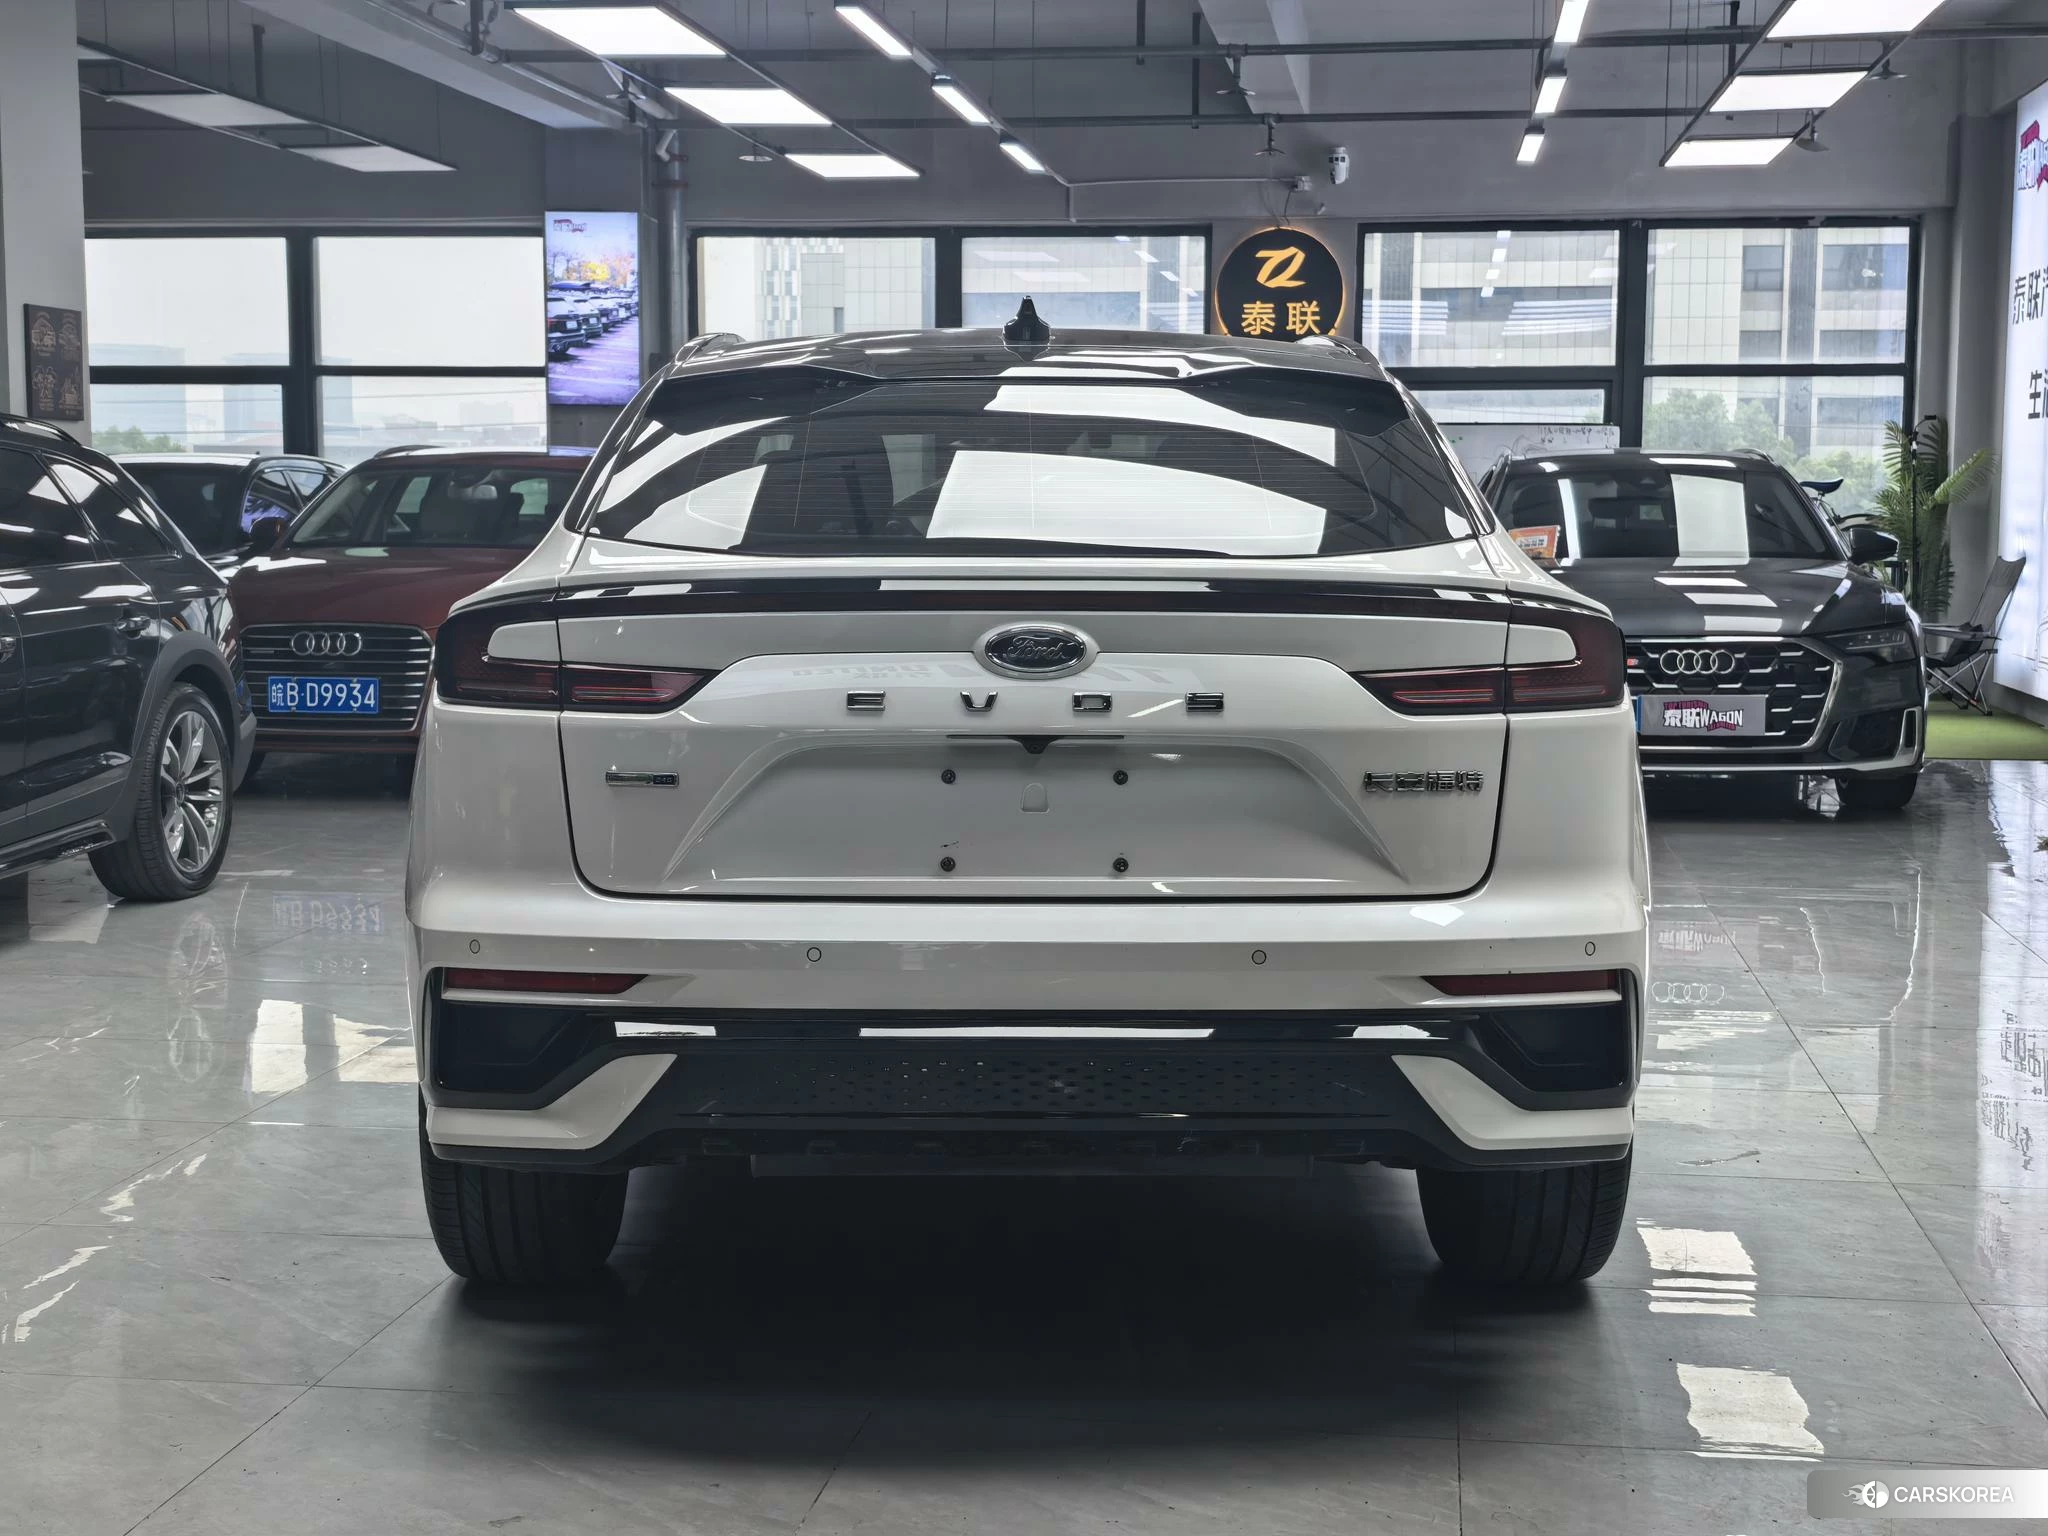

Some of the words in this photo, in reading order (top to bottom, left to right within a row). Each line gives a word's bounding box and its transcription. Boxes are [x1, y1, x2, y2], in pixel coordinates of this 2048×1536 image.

[1241, 301, 1320, 335] 泰联
[1007, 635, 1068, 660] Ford
[846, 690, 1224, 713] EVOS
[1364, 770, 1484, 792] 长安福特
